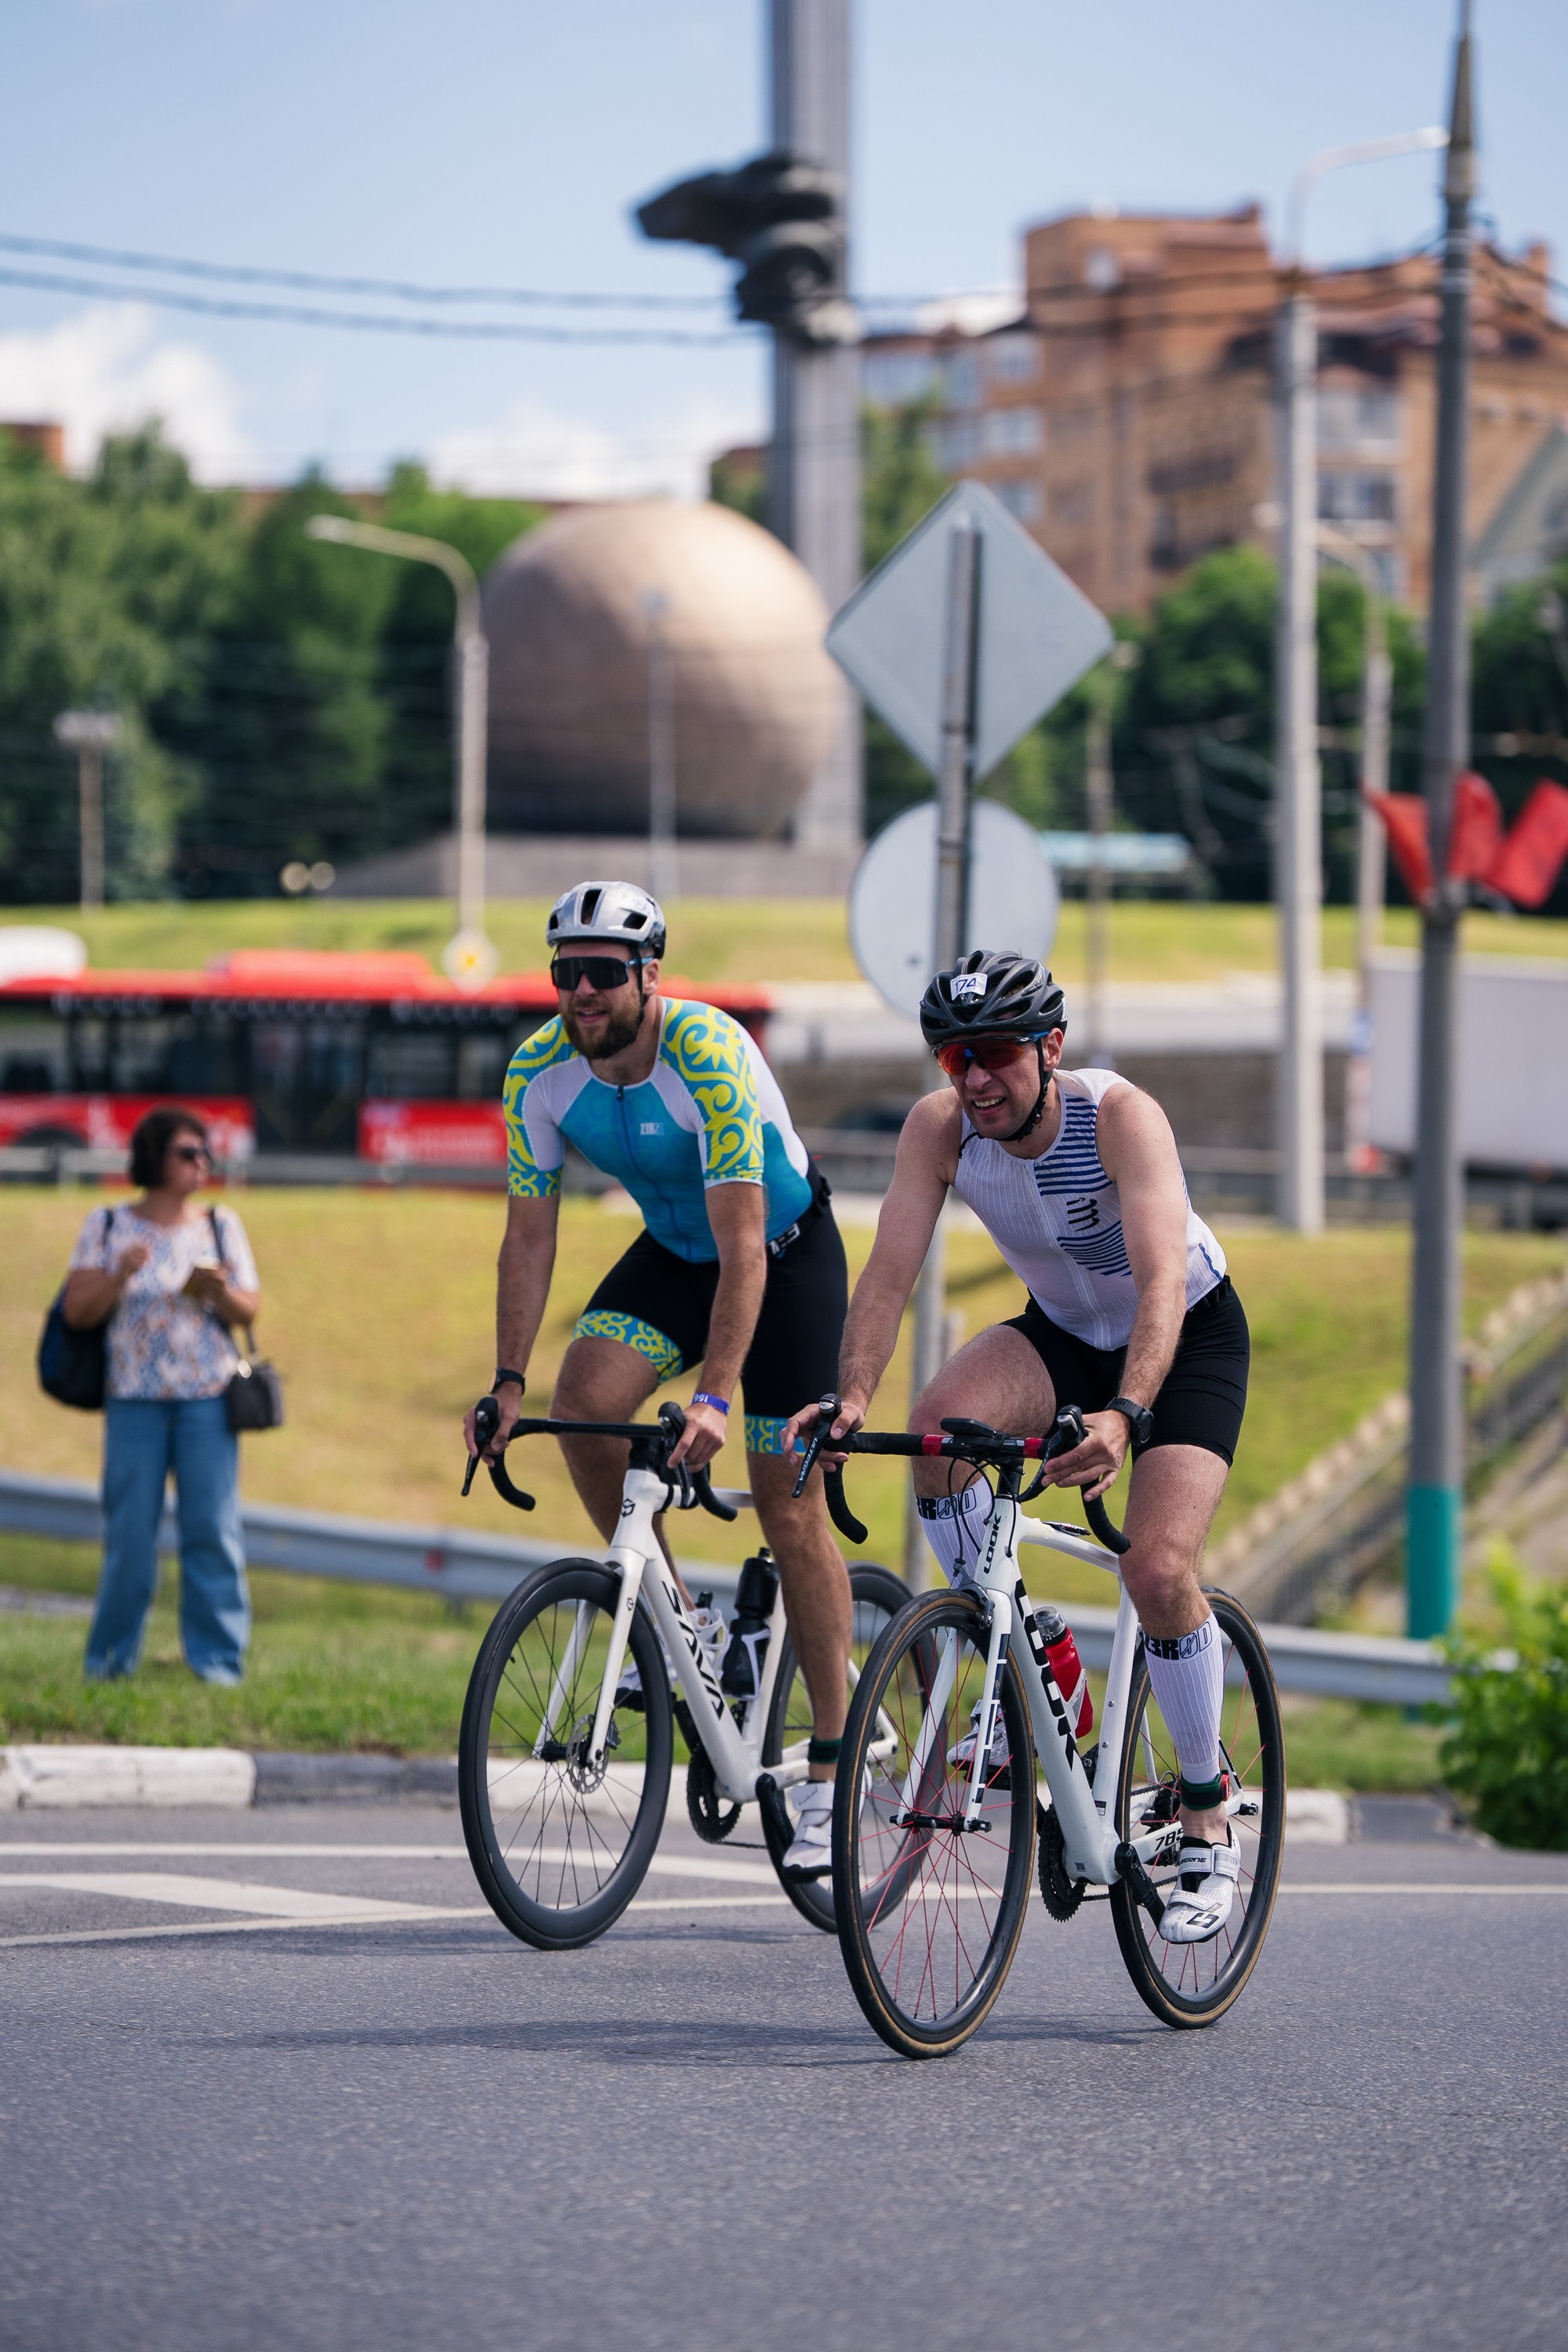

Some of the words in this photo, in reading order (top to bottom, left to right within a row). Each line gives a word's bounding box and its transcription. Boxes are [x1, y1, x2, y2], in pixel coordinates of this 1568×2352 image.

[955, 978, 977, 994] 174
[799, 1437, 818, 1481] ULTEGRA
[983, 1512, 1002, 1574] LOOK
[661, 1581, 725, 1720] SAVA
[1014, 1578, 1081, 1772] LOOK
